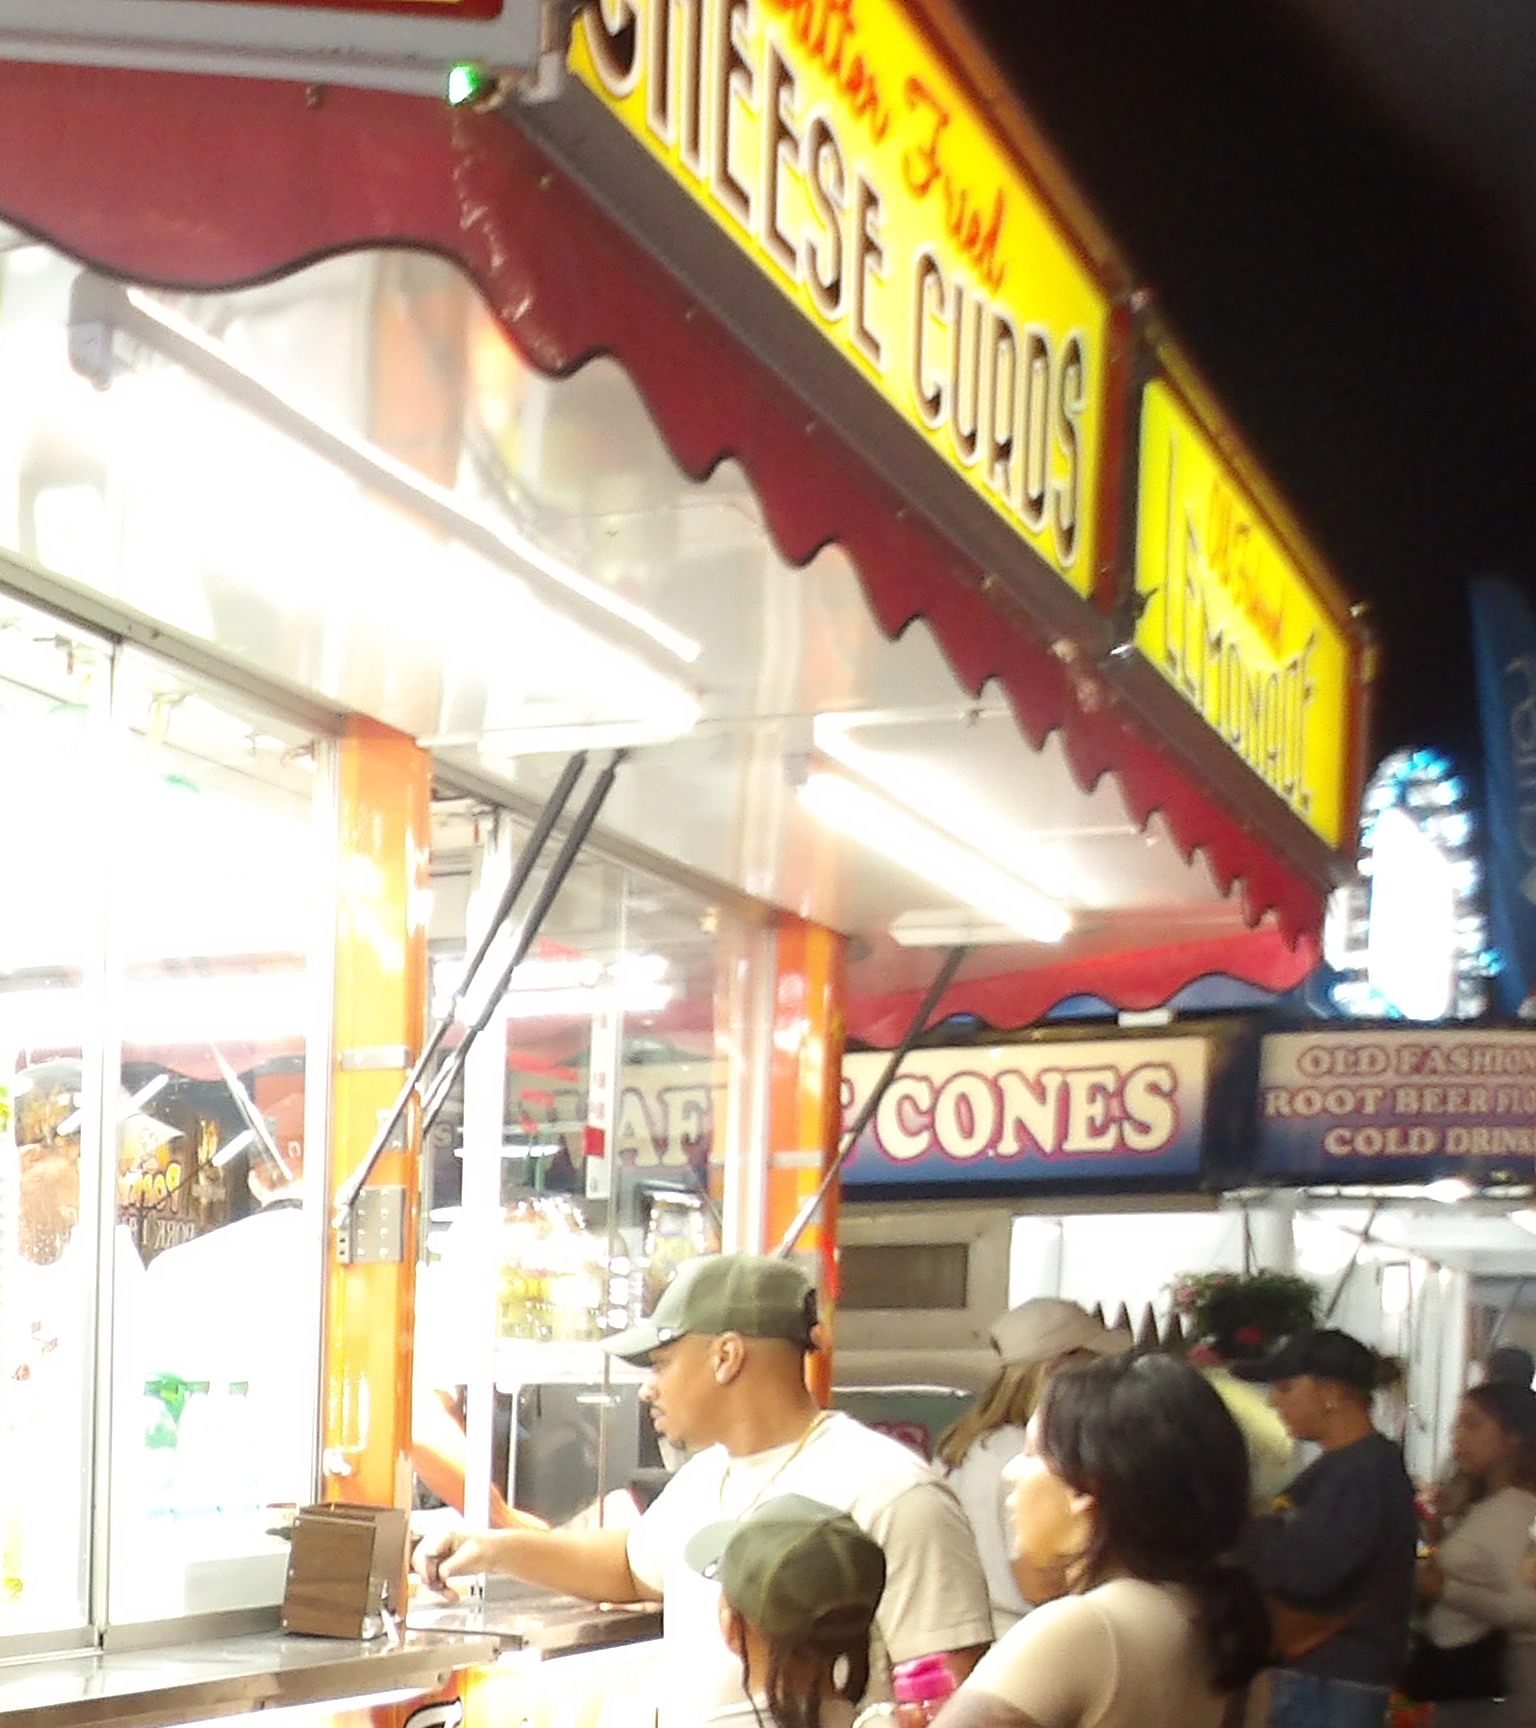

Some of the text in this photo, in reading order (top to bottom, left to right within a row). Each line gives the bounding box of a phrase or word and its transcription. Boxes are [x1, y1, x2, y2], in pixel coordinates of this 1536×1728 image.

[901, 76, 1008, 293] Fried
[911, 241, 1087, 570] CURDS
[1297, 1045, 1390, 1077] OLD
[874, 1061, 1178, 1166] CONES
[1264, 1086, 1385, 1118] ROOT
[1393, 1084, 1491, 1117] BEER
[1323, 1124, 1536, 1158] COLD DRIN
